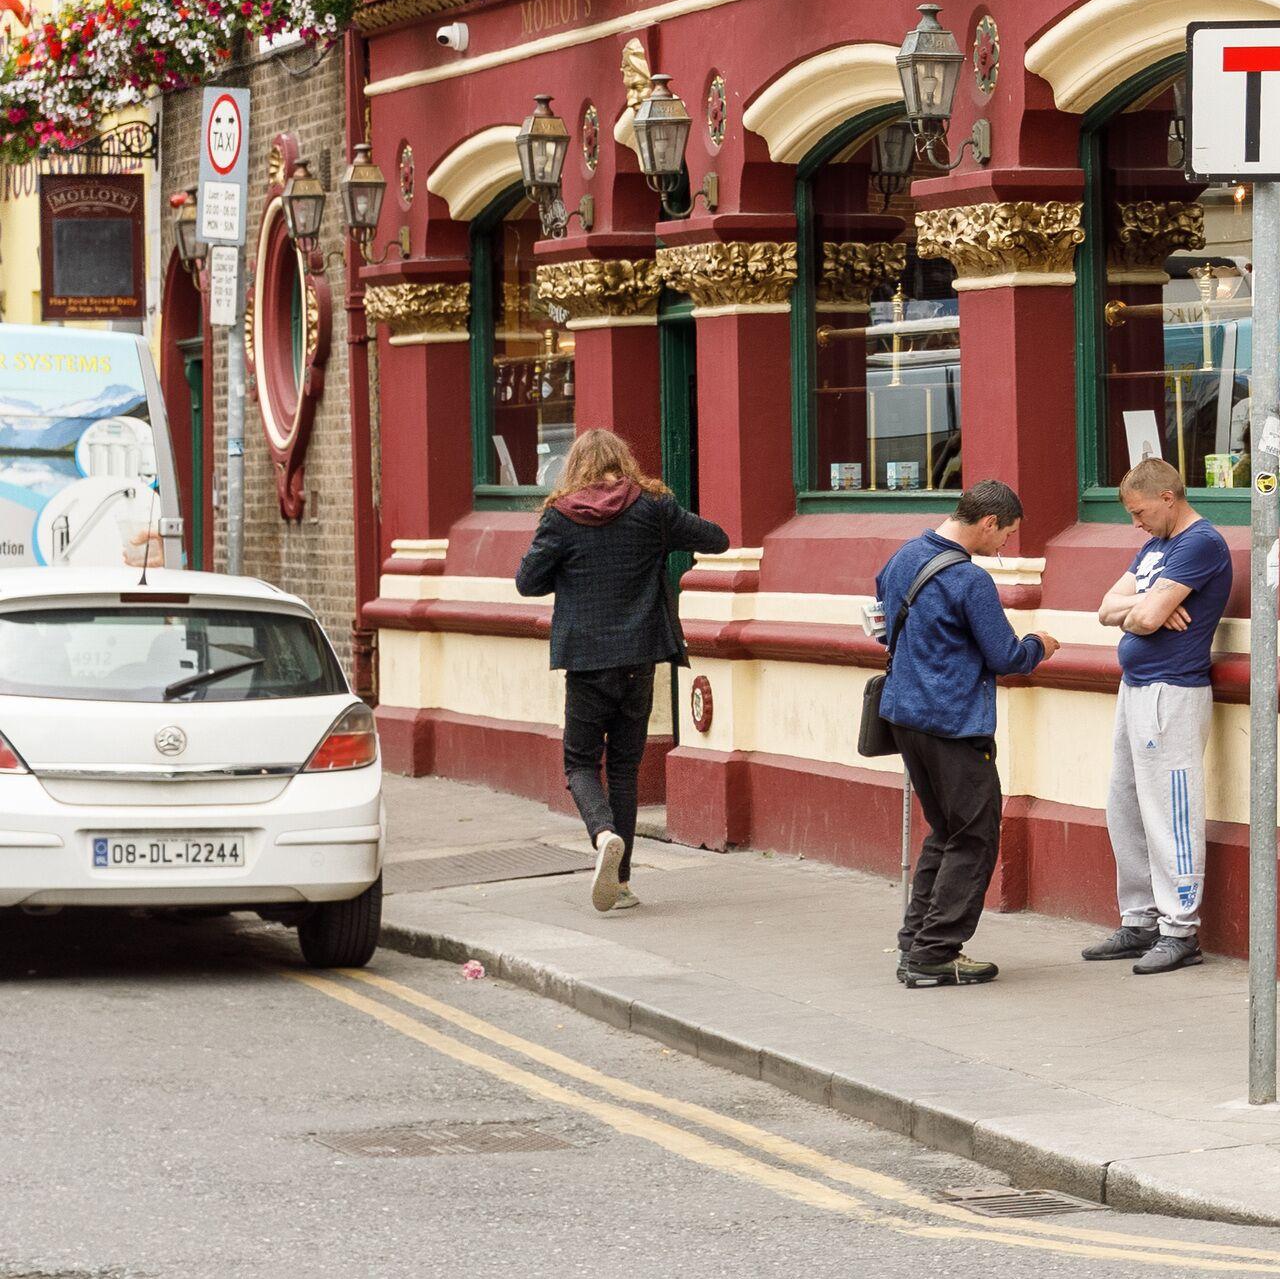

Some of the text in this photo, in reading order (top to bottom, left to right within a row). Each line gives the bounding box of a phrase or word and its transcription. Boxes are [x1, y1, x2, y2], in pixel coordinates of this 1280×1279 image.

[213, 131, 236, 152] TAXI
[51, 187, 131, 208] MOLLOY'S
[14, 352, 113, 374] SYSTEMS
[112, 843, 240, 864] 08-DL-12244
